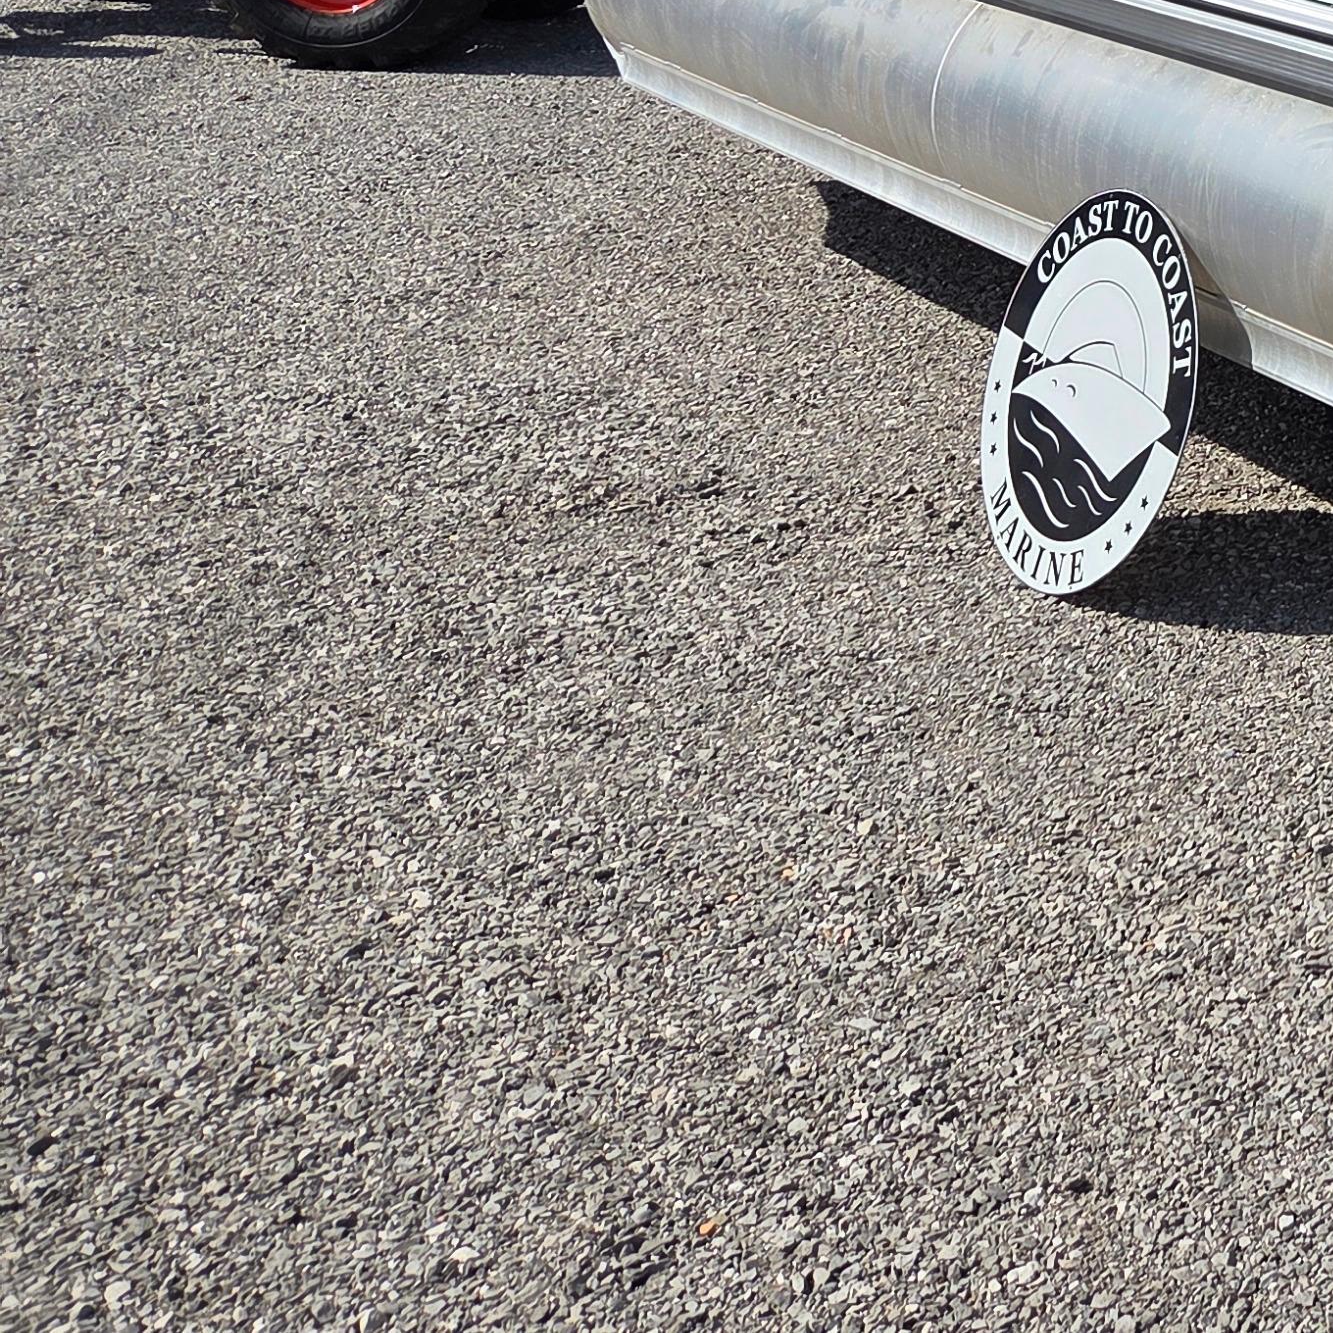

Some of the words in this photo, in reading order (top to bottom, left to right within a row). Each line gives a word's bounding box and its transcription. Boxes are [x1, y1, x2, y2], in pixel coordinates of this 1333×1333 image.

[1036, 199, 1119, 284] COAST
[1121, 200, 1154, 243] TO
[1152, 233, 1192, 378] COAST
[989, 476, 1085, 588] MARINE
